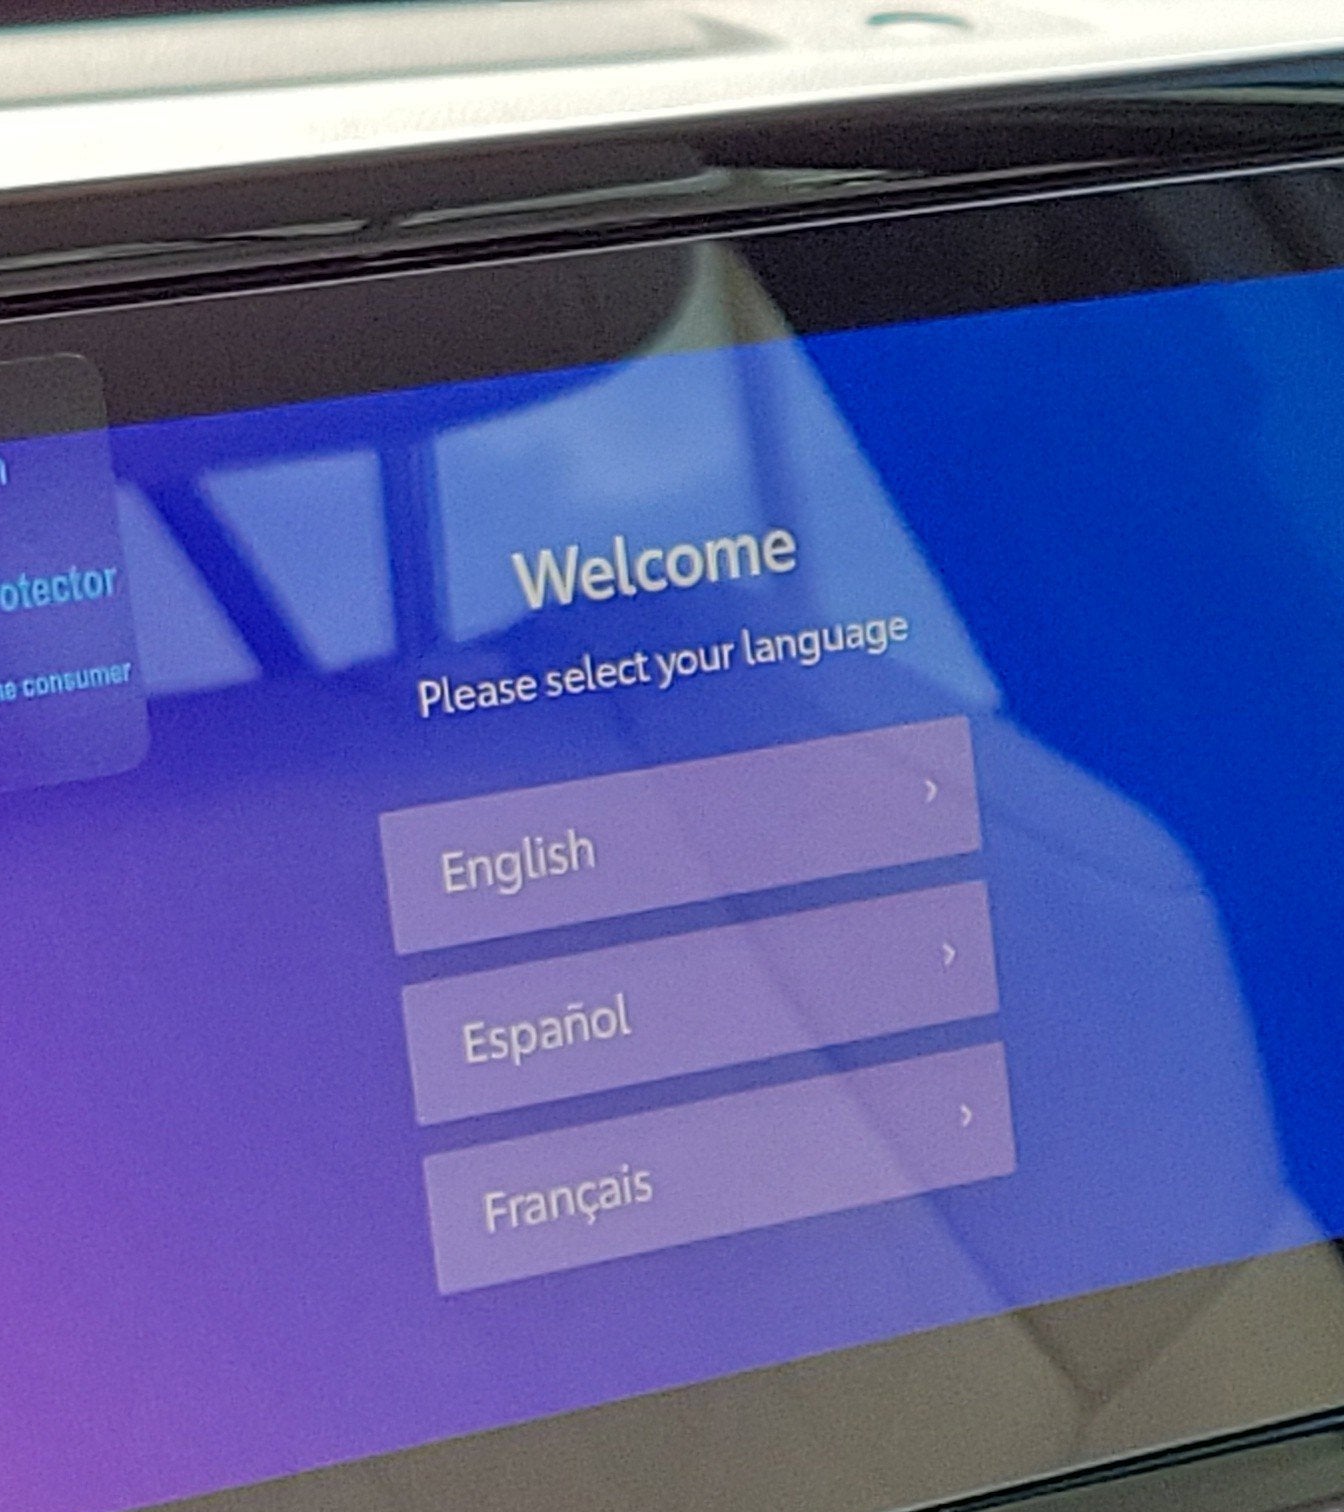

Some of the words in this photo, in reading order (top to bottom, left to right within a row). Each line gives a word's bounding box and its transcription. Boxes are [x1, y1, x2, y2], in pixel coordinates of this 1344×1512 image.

[510, 526, 798, 611] Welcome
[21, 661, 133, 699] consumer
[417, 676, 537, 719] Please
[547, 650, 651, 698] select
[654, 640, 736, 690] your
[741, 614, 910, 667] language
[441, 828, 596, 896] English
[463, 992, 632, 1067] Español
[483, 1162, 654, 1234] Français
